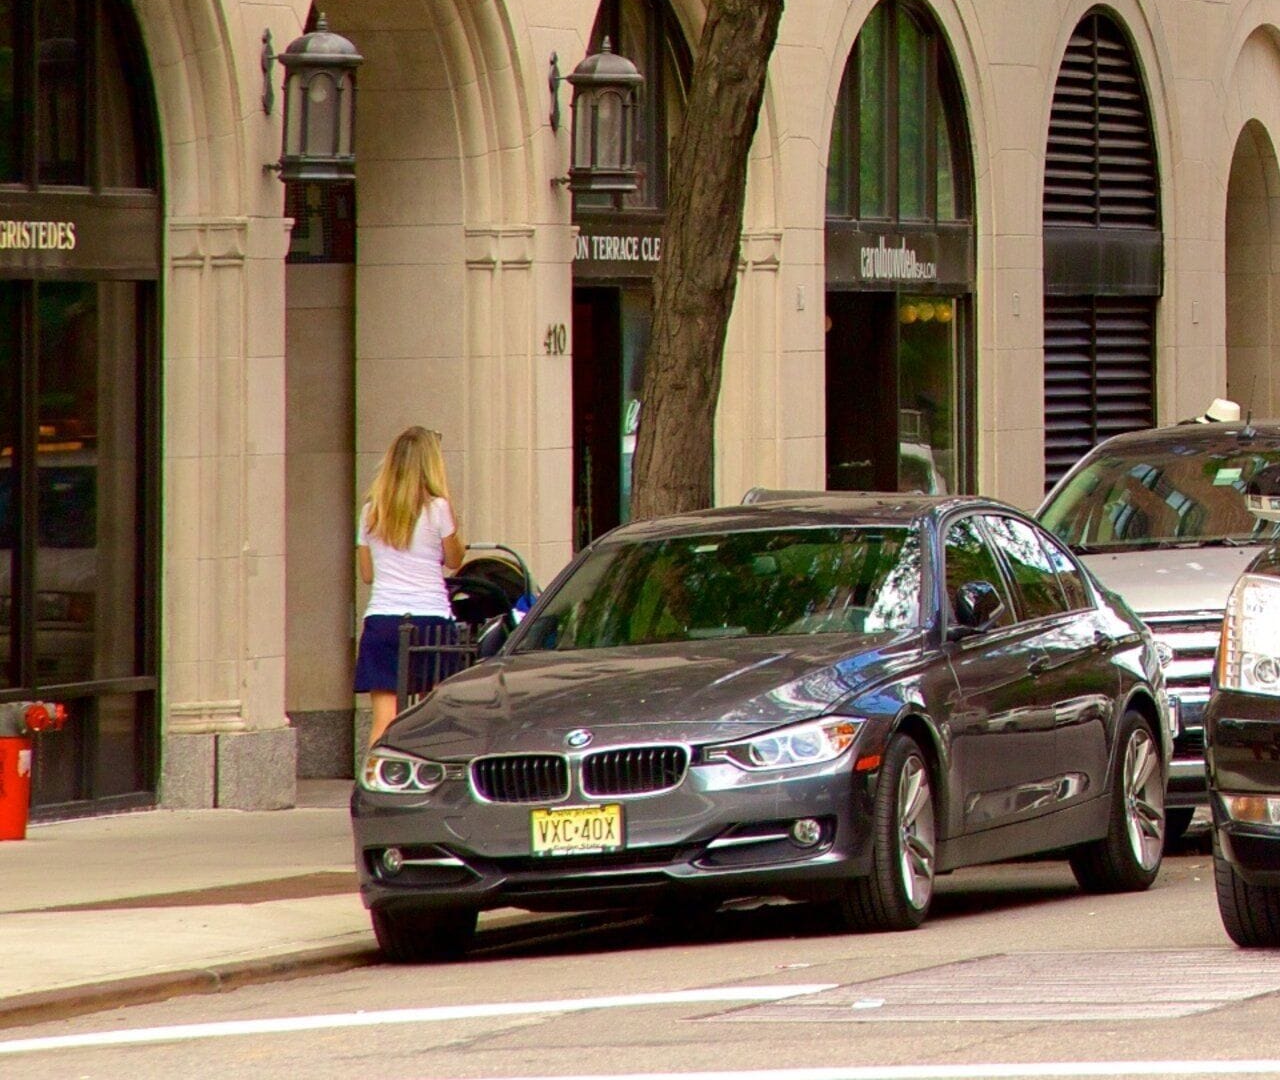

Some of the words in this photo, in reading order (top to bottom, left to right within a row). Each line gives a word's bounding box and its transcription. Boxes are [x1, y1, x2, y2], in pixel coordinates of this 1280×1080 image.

[0, 221, 76, 249] GRISTEDES
[592, 236, 639, 260] TERRACE
[543, 323, 566, 355] 410
